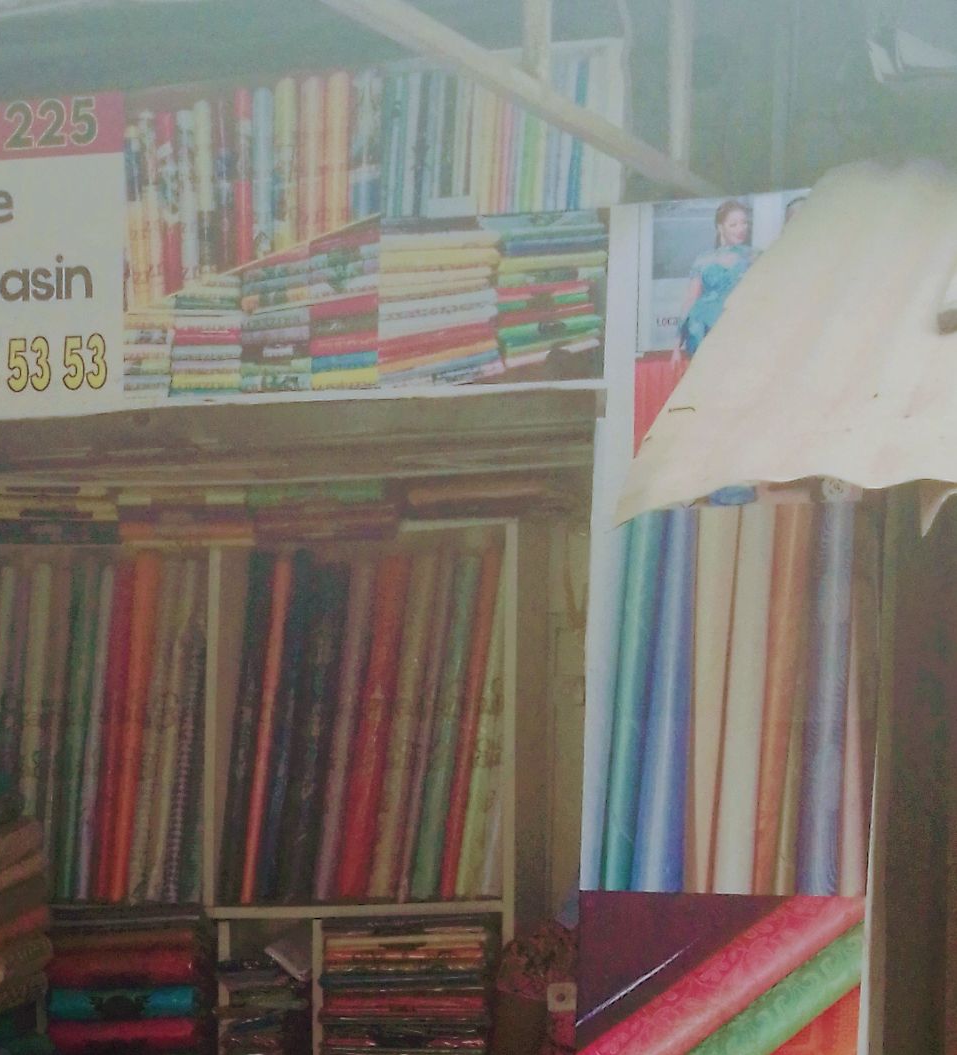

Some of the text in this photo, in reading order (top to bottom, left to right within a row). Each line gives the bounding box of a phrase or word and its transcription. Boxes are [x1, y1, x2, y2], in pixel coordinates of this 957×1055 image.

[2, 97, 98, 152] 225
[6, 336, 51, 391] 53
[62, 332, 108, 390] 53
